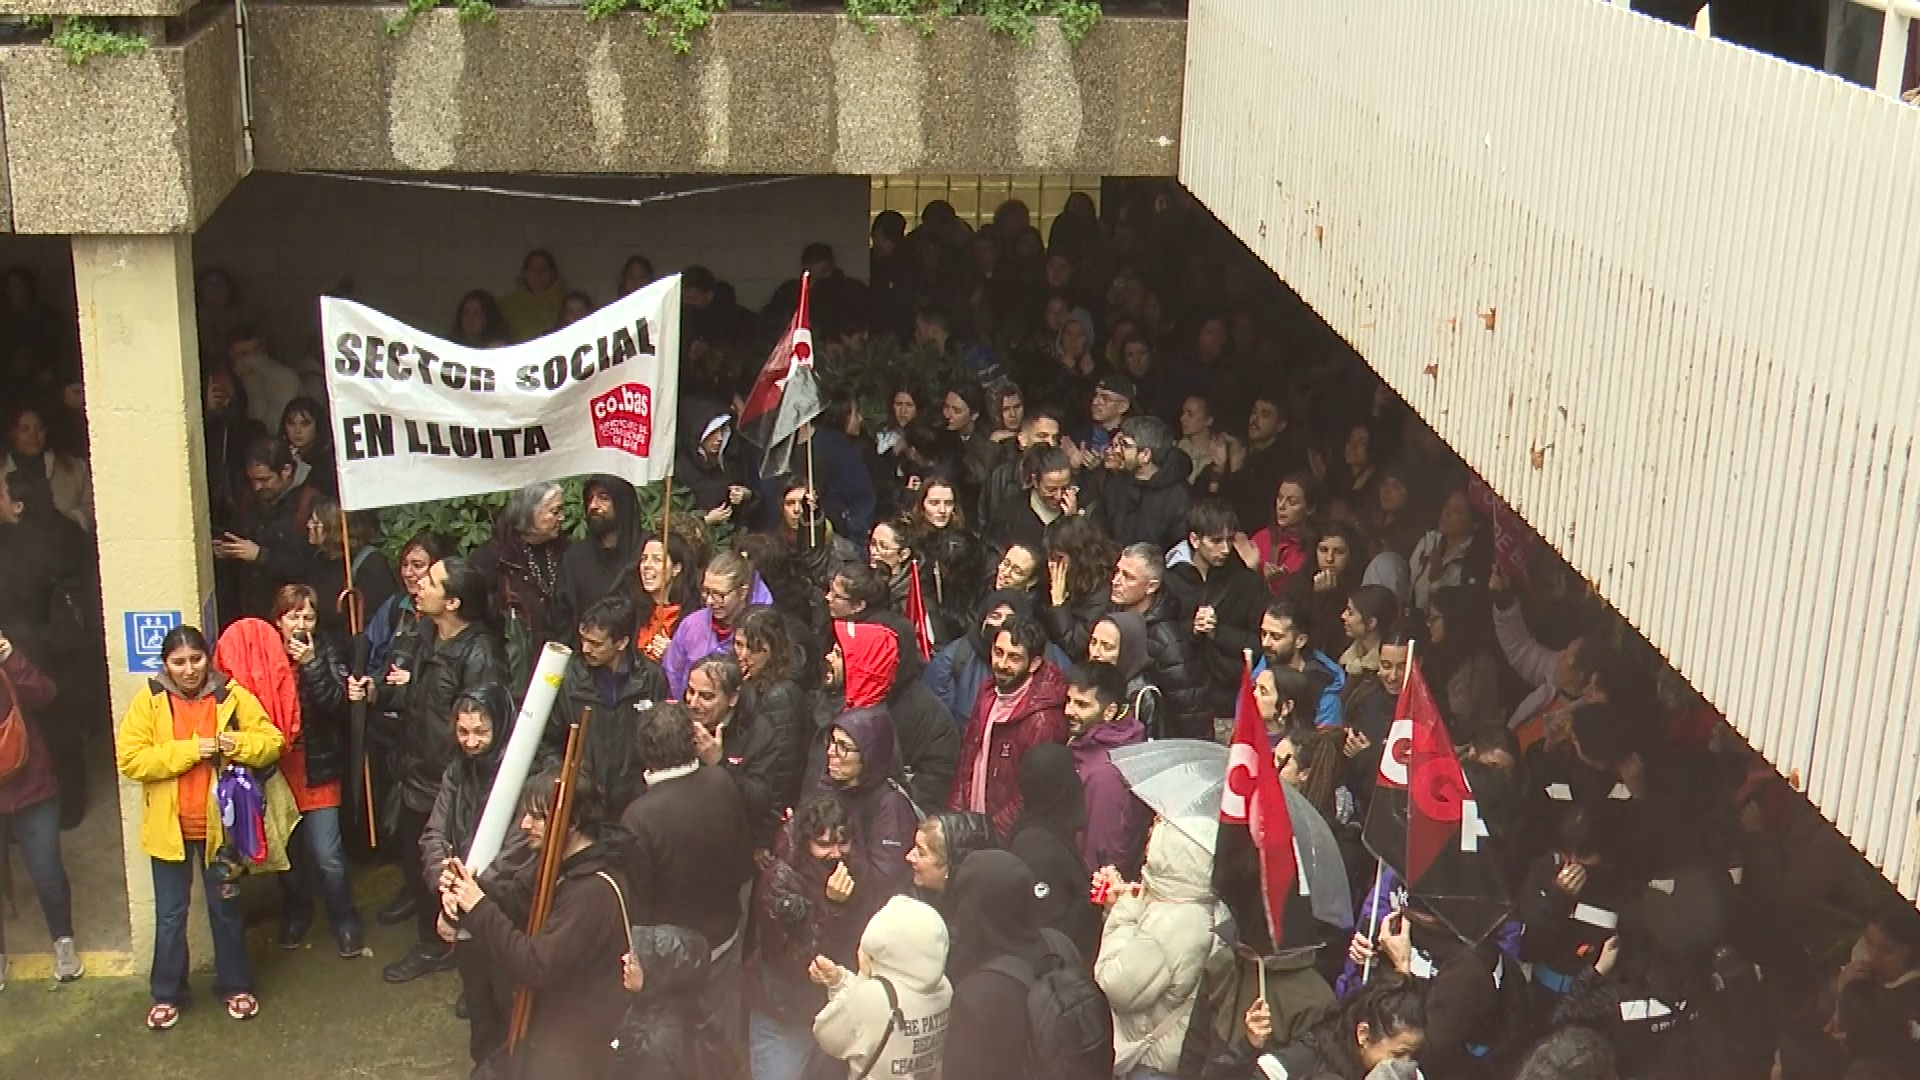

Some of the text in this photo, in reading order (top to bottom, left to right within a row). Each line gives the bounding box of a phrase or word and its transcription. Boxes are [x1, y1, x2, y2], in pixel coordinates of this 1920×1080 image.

[335, 316, 656, 392] SECTOR SOCIAL
[594, 386, 648, 418] co.bas
[343, 413, 551, 460] EN LLUITA
[904, 1019, 919, 1036] BE
